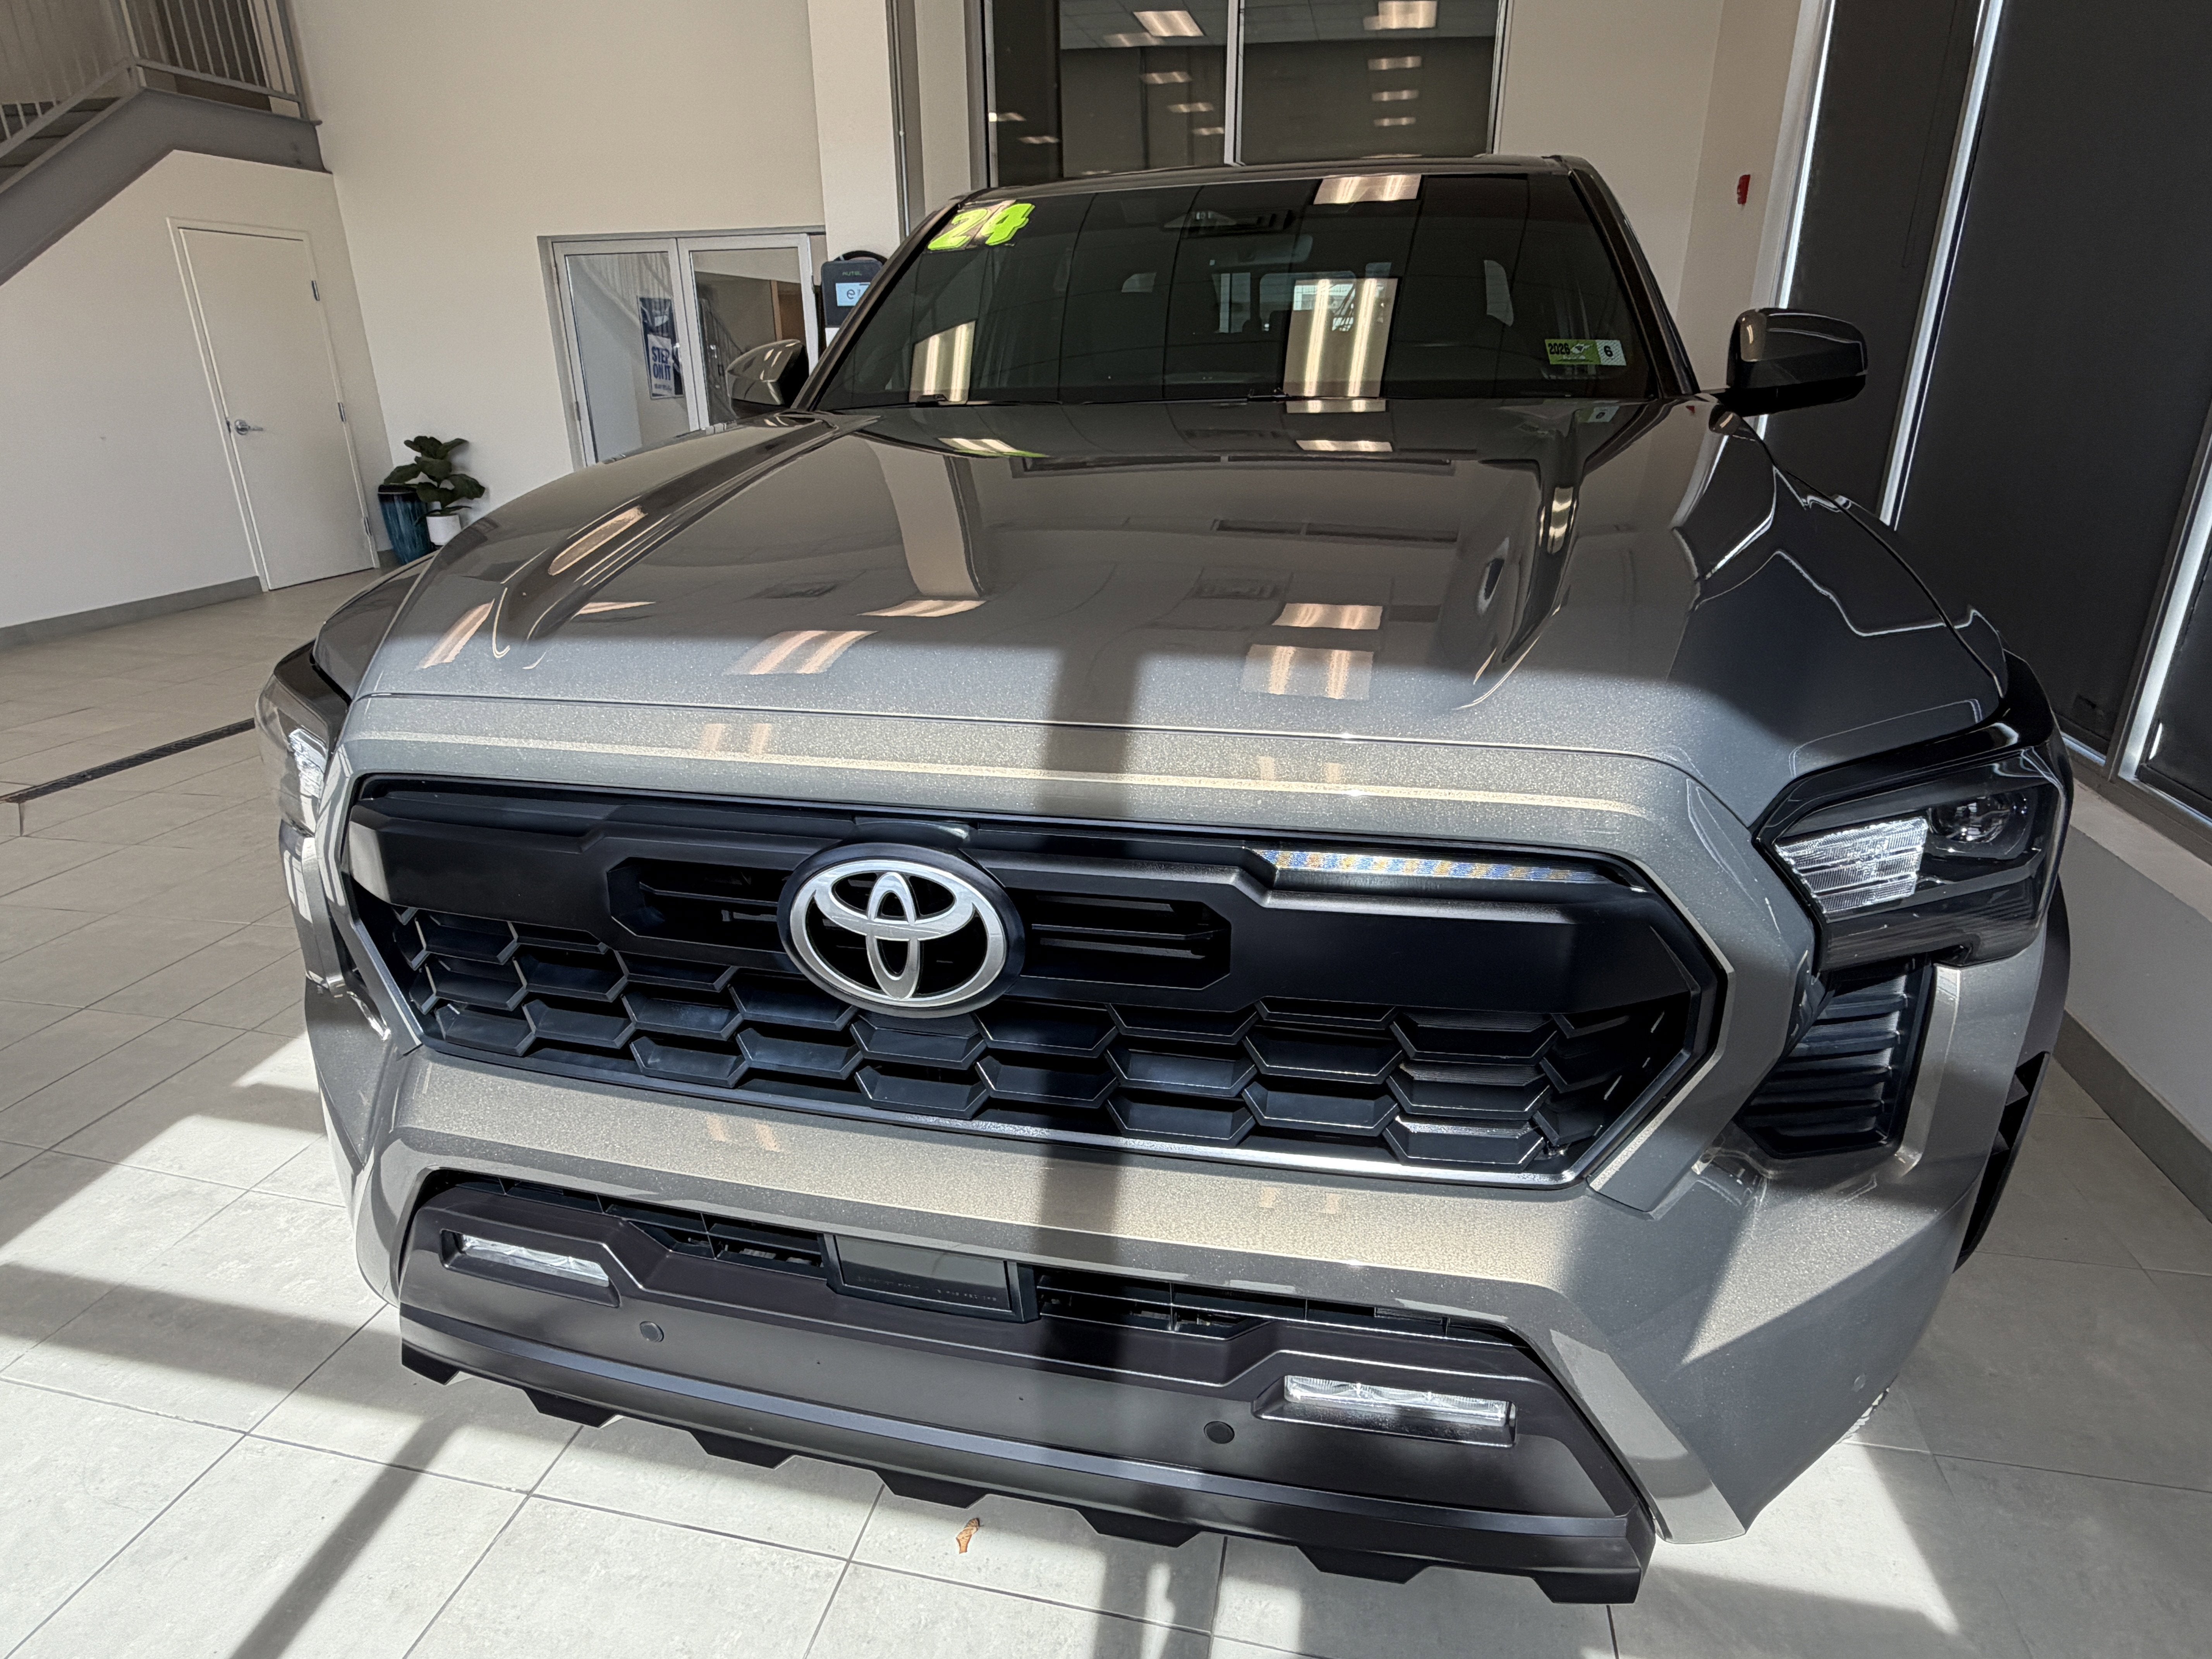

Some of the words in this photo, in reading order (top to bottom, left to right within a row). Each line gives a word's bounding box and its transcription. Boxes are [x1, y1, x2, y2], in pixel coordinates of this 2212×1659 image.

[927, 203, 1036, 250] 24
[651, 346, 670, 364] STEP
[1548, 342, 1570, 355] 2026
[1604, 345, 1613, 357] 6
[653, 364, 663, 380] ON
[665, 365, 671, 381] IT
